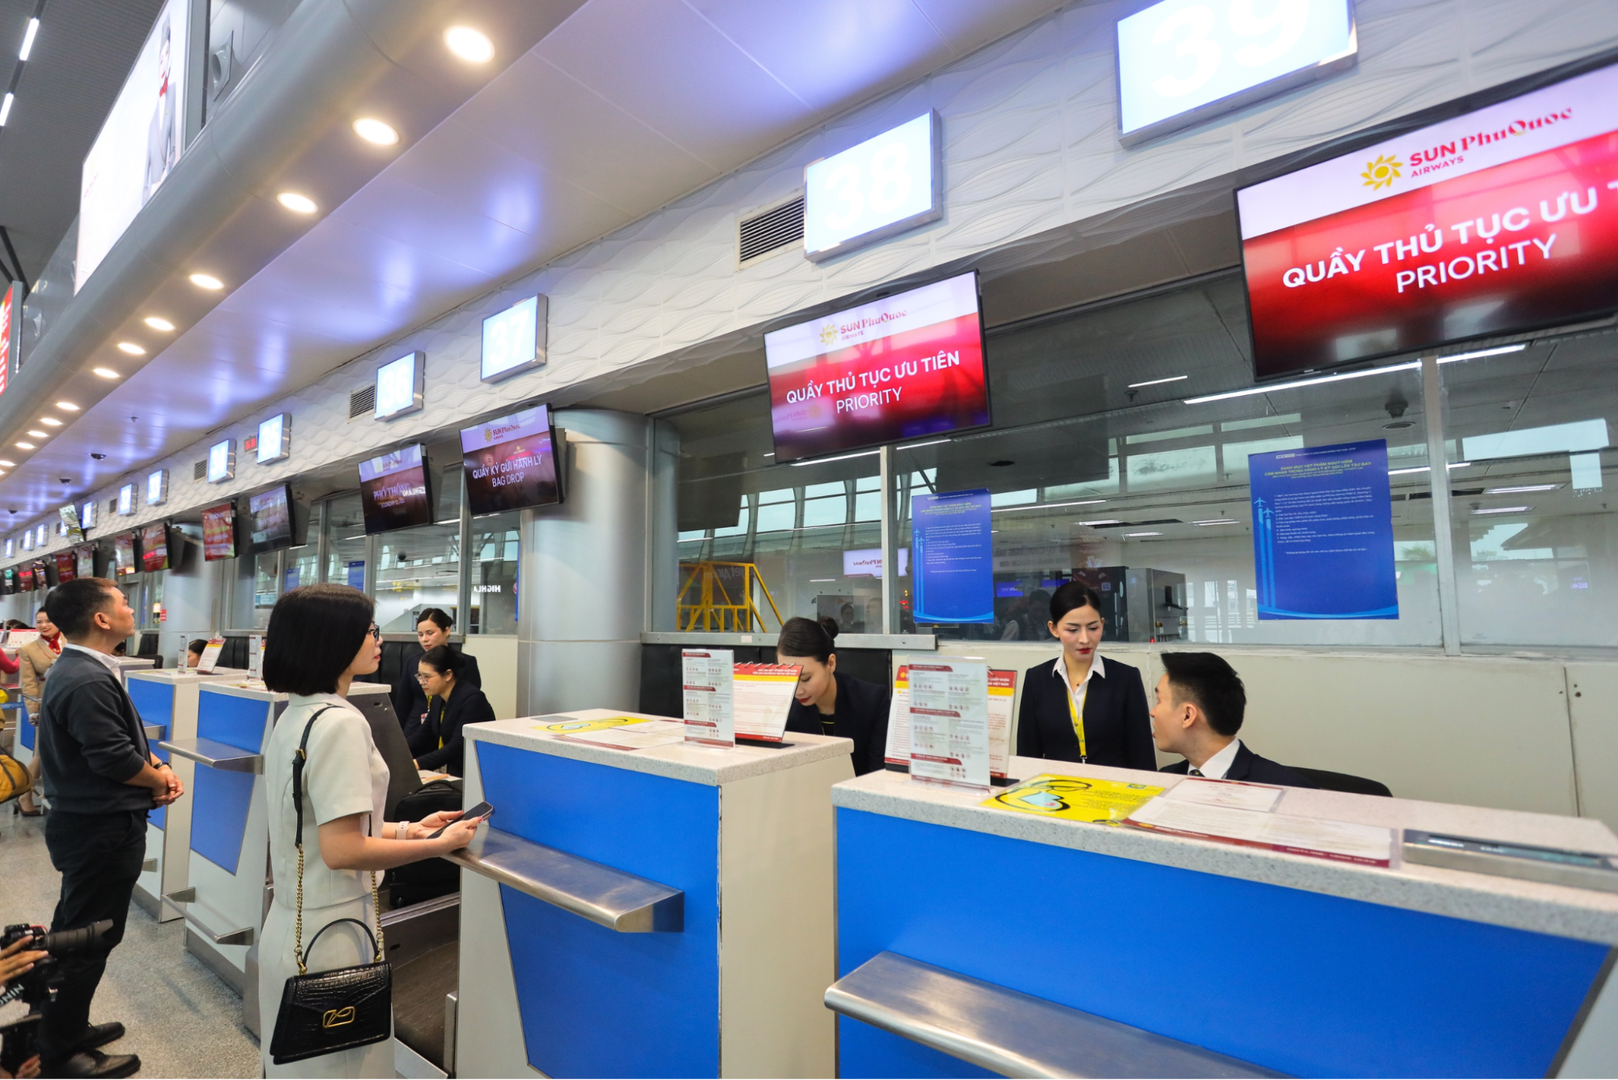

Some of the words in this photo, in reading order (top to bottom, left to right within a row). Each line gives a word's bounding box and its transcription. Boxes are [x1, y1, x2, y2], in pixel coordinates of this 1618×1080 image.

[1151, 0, 1309, 98] 39
[1409, 141, 1457, 167] SUN
[1461, 107, 1572, 151] PhuQuoc
[1411, 155, 1464, 178] AIRWAYS
[824, 142, 912, 231] 38
[1282, 246, 1366, 288] QUẦY
[1373, 223, 1443, 265] THỦ
[1450, 206, 1531, 245] TỤC
[1539, 186, 1599, 223] ƯU
[1395, 233, 1557, 293] PRIORITY
[490, 309, 529, 366] 37
[840, 320, 861, 334] SUN
[841, 330, 864, 340] AIRWAYS
[381, 364, 409, 408] 36
[786, 379, 823, 404] QUẦY
[826, 371, 856, 395] THỦ
[858, 367, 892, 388] TỤC
[894, 360, 918, 379] ƯU
[921, 350, 960, 372] TIÊN
[836, 386, 903, 414] PRIORITY
[260, 421, 280, 456] 35
[211, 446, 226, 477] 34
[490, 462, 500, 476] KÝ
[533, 452, 542, 466] LÝ
[491, 476, 506, 487] BAG
[506, 472, 525, 485] DROP
